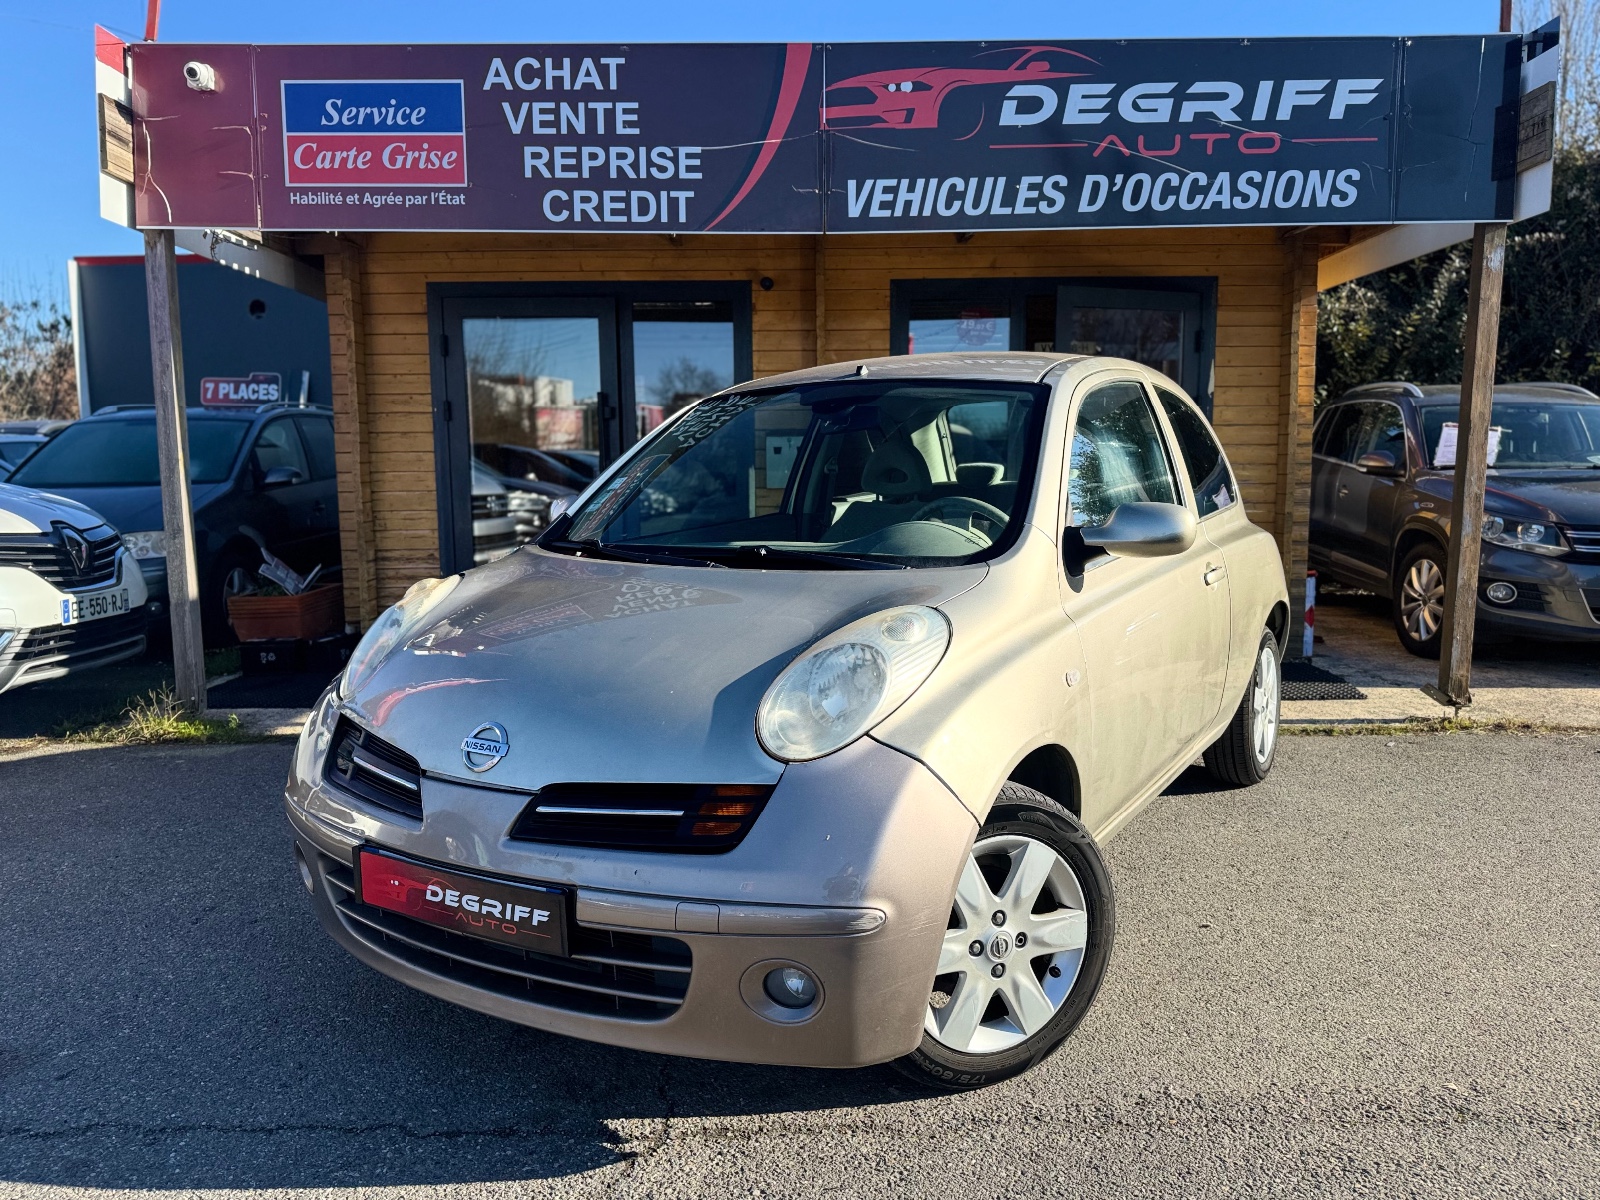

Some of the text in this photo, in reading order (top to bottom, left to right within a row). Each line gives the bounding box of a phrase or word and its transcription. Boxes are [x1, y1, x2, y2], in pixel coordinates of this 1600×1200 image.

[482, 56, 626, 91] ACHAT
[320, 98, 427, 126] Service
[501, 101, 641, 135] VENTE
[998, 78, 1385, 127] DEGRIFF
[293, 142, 458, 170] Carte Grise
[1092, 131, 1281, 158] AUTO
[523, 145, 703, 180] REPRISE
[289, 189, 466, 208] Habilité et Agrée par l’État
[542, 189, 695, 223] CREDIT
[847, 168, 1361, 218] VEHICULES D’OCCASIONS
[205, 382, 279, 401] 7 PLACES
[464, 740, 501, 753] NISSAN
[425, 884, 551, 926] DEGRIFF
[455, 911, 517, 935] AUTO
